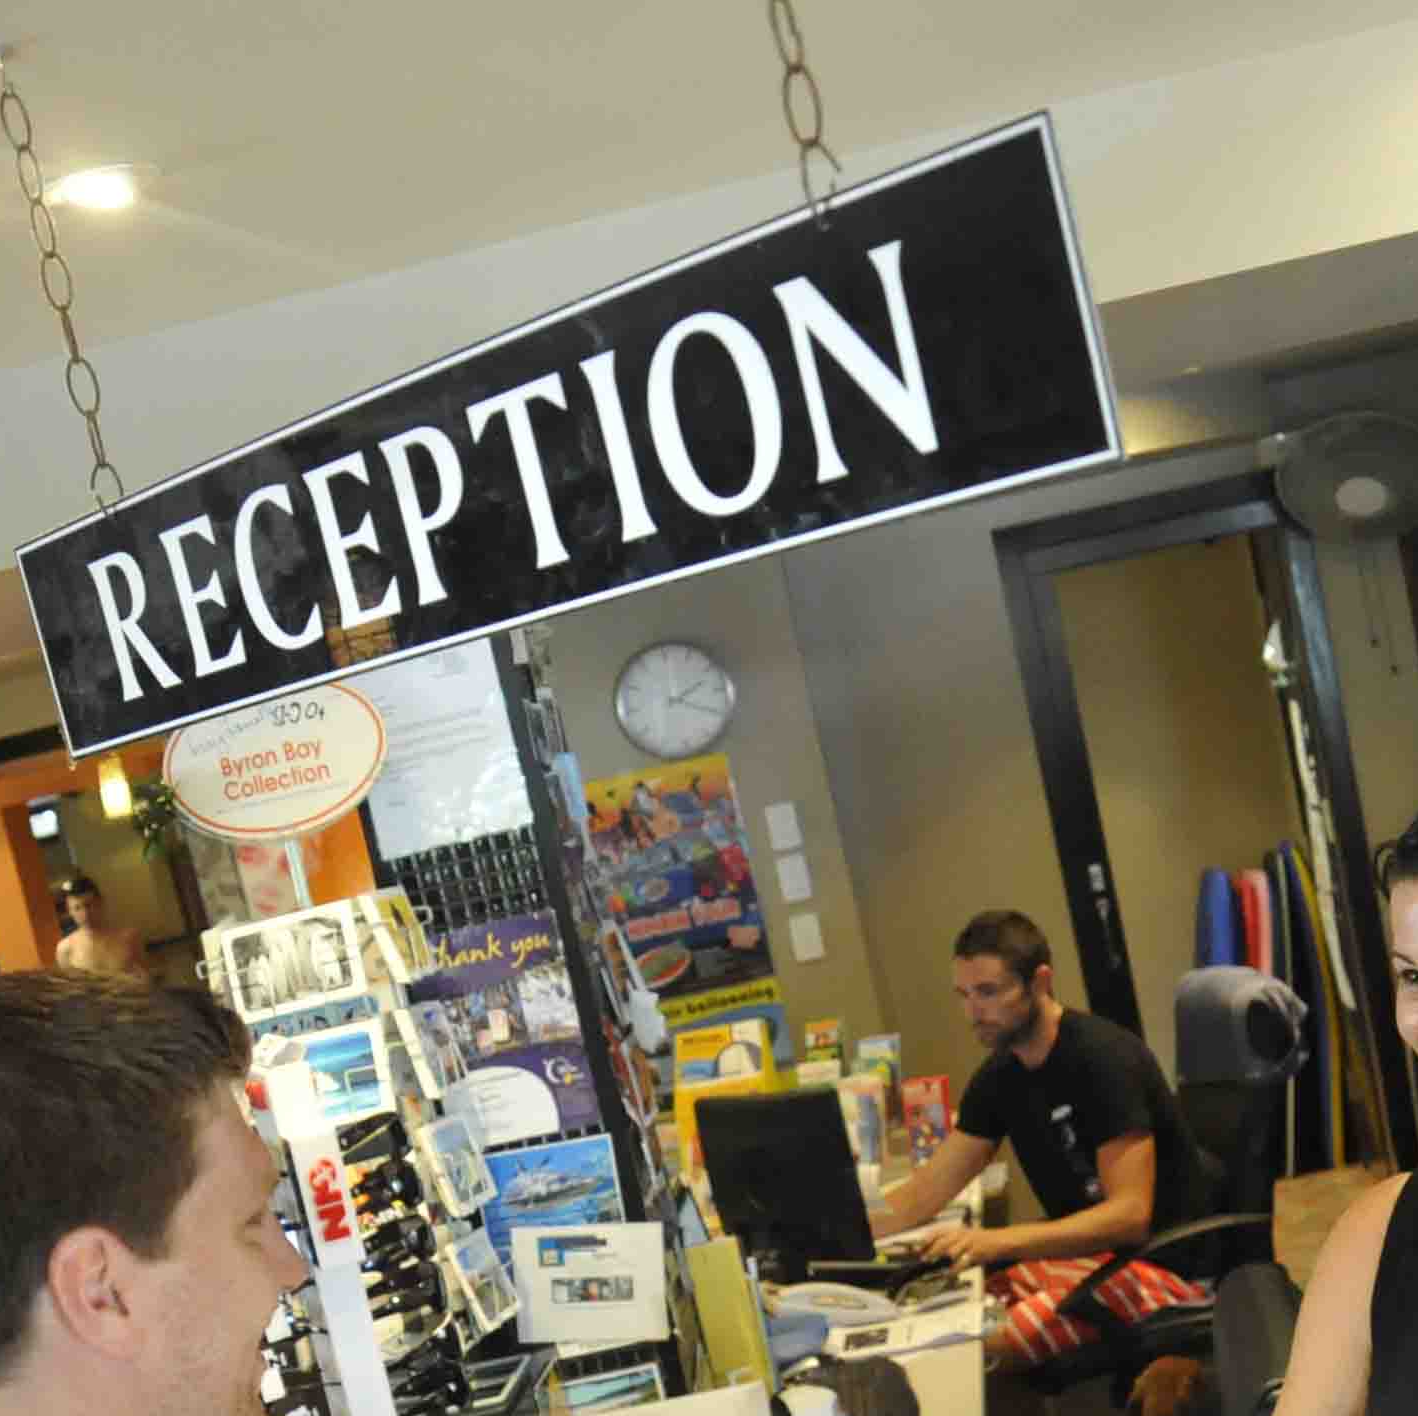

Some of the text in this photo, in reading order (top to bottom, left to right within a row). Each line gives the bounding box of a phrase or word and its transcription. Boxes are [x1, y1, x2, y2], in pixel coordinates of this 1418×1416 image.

[85, 240, 939, 703] RECEPTION
[220, 737, 324, 780] Byron Bay
[223, 763, 332, 801] Collection
[438, 931, 551, 968] hank you
